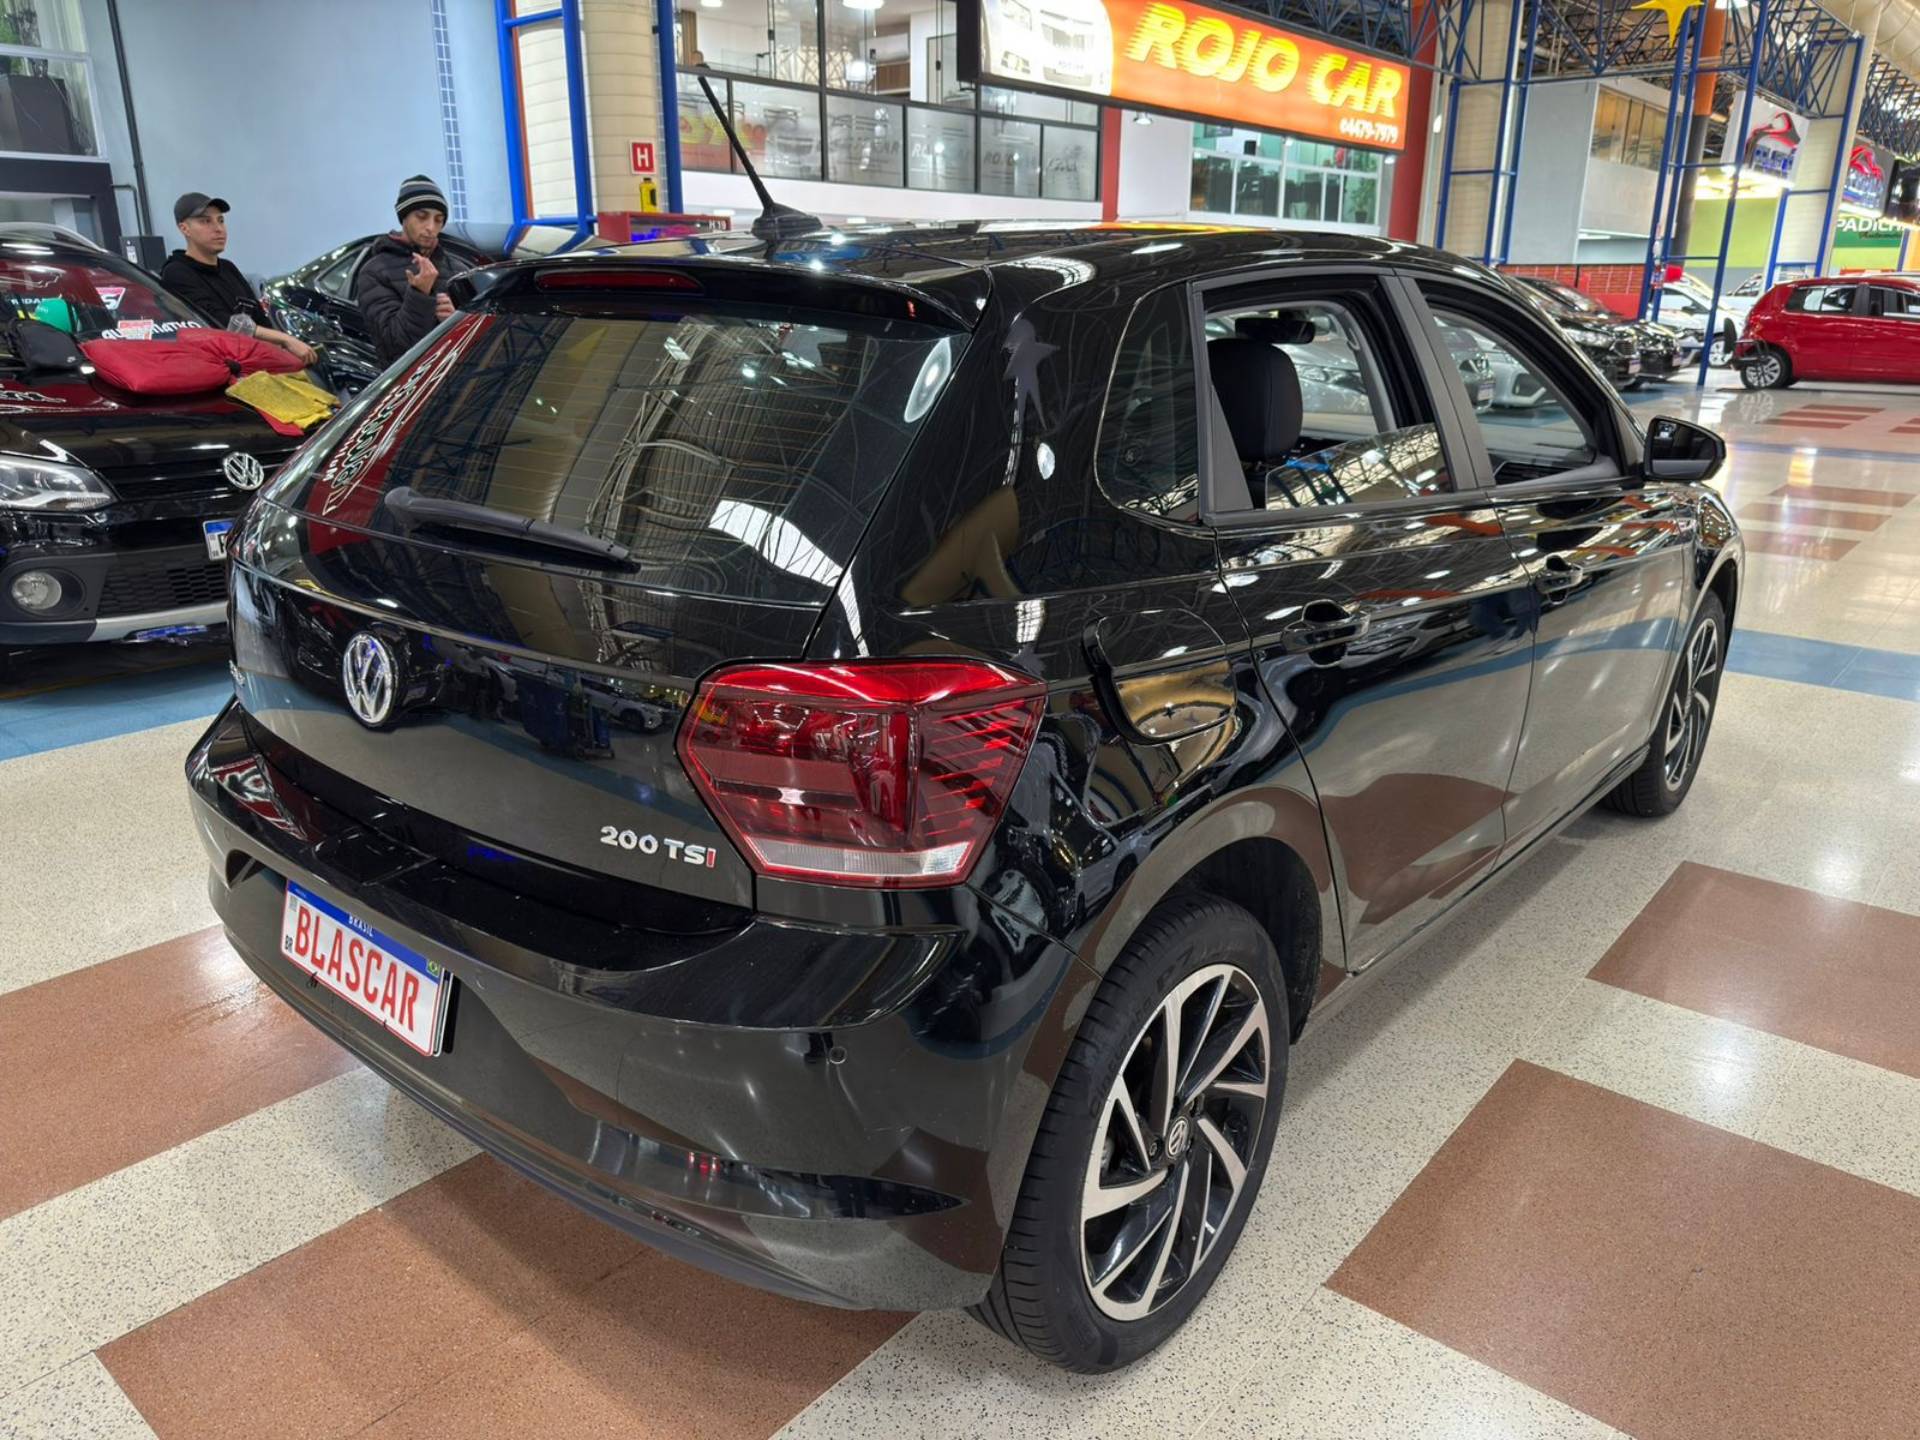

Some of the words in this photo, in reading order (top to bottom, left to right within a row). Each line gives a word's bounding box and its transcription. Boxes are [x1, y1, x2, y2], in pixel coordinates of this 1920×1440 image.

[1126, 4, 1300, 92] ROJO
[1306, 53, 1402, 117] CAR
[637, 147, 650, 168] H
[600, 825, 659, 855] 200
[663, 838, 717, 868] TSI
[348, 915, 374, 937] BRASIL
[294, 905, 420, 1032] BLASCAR
